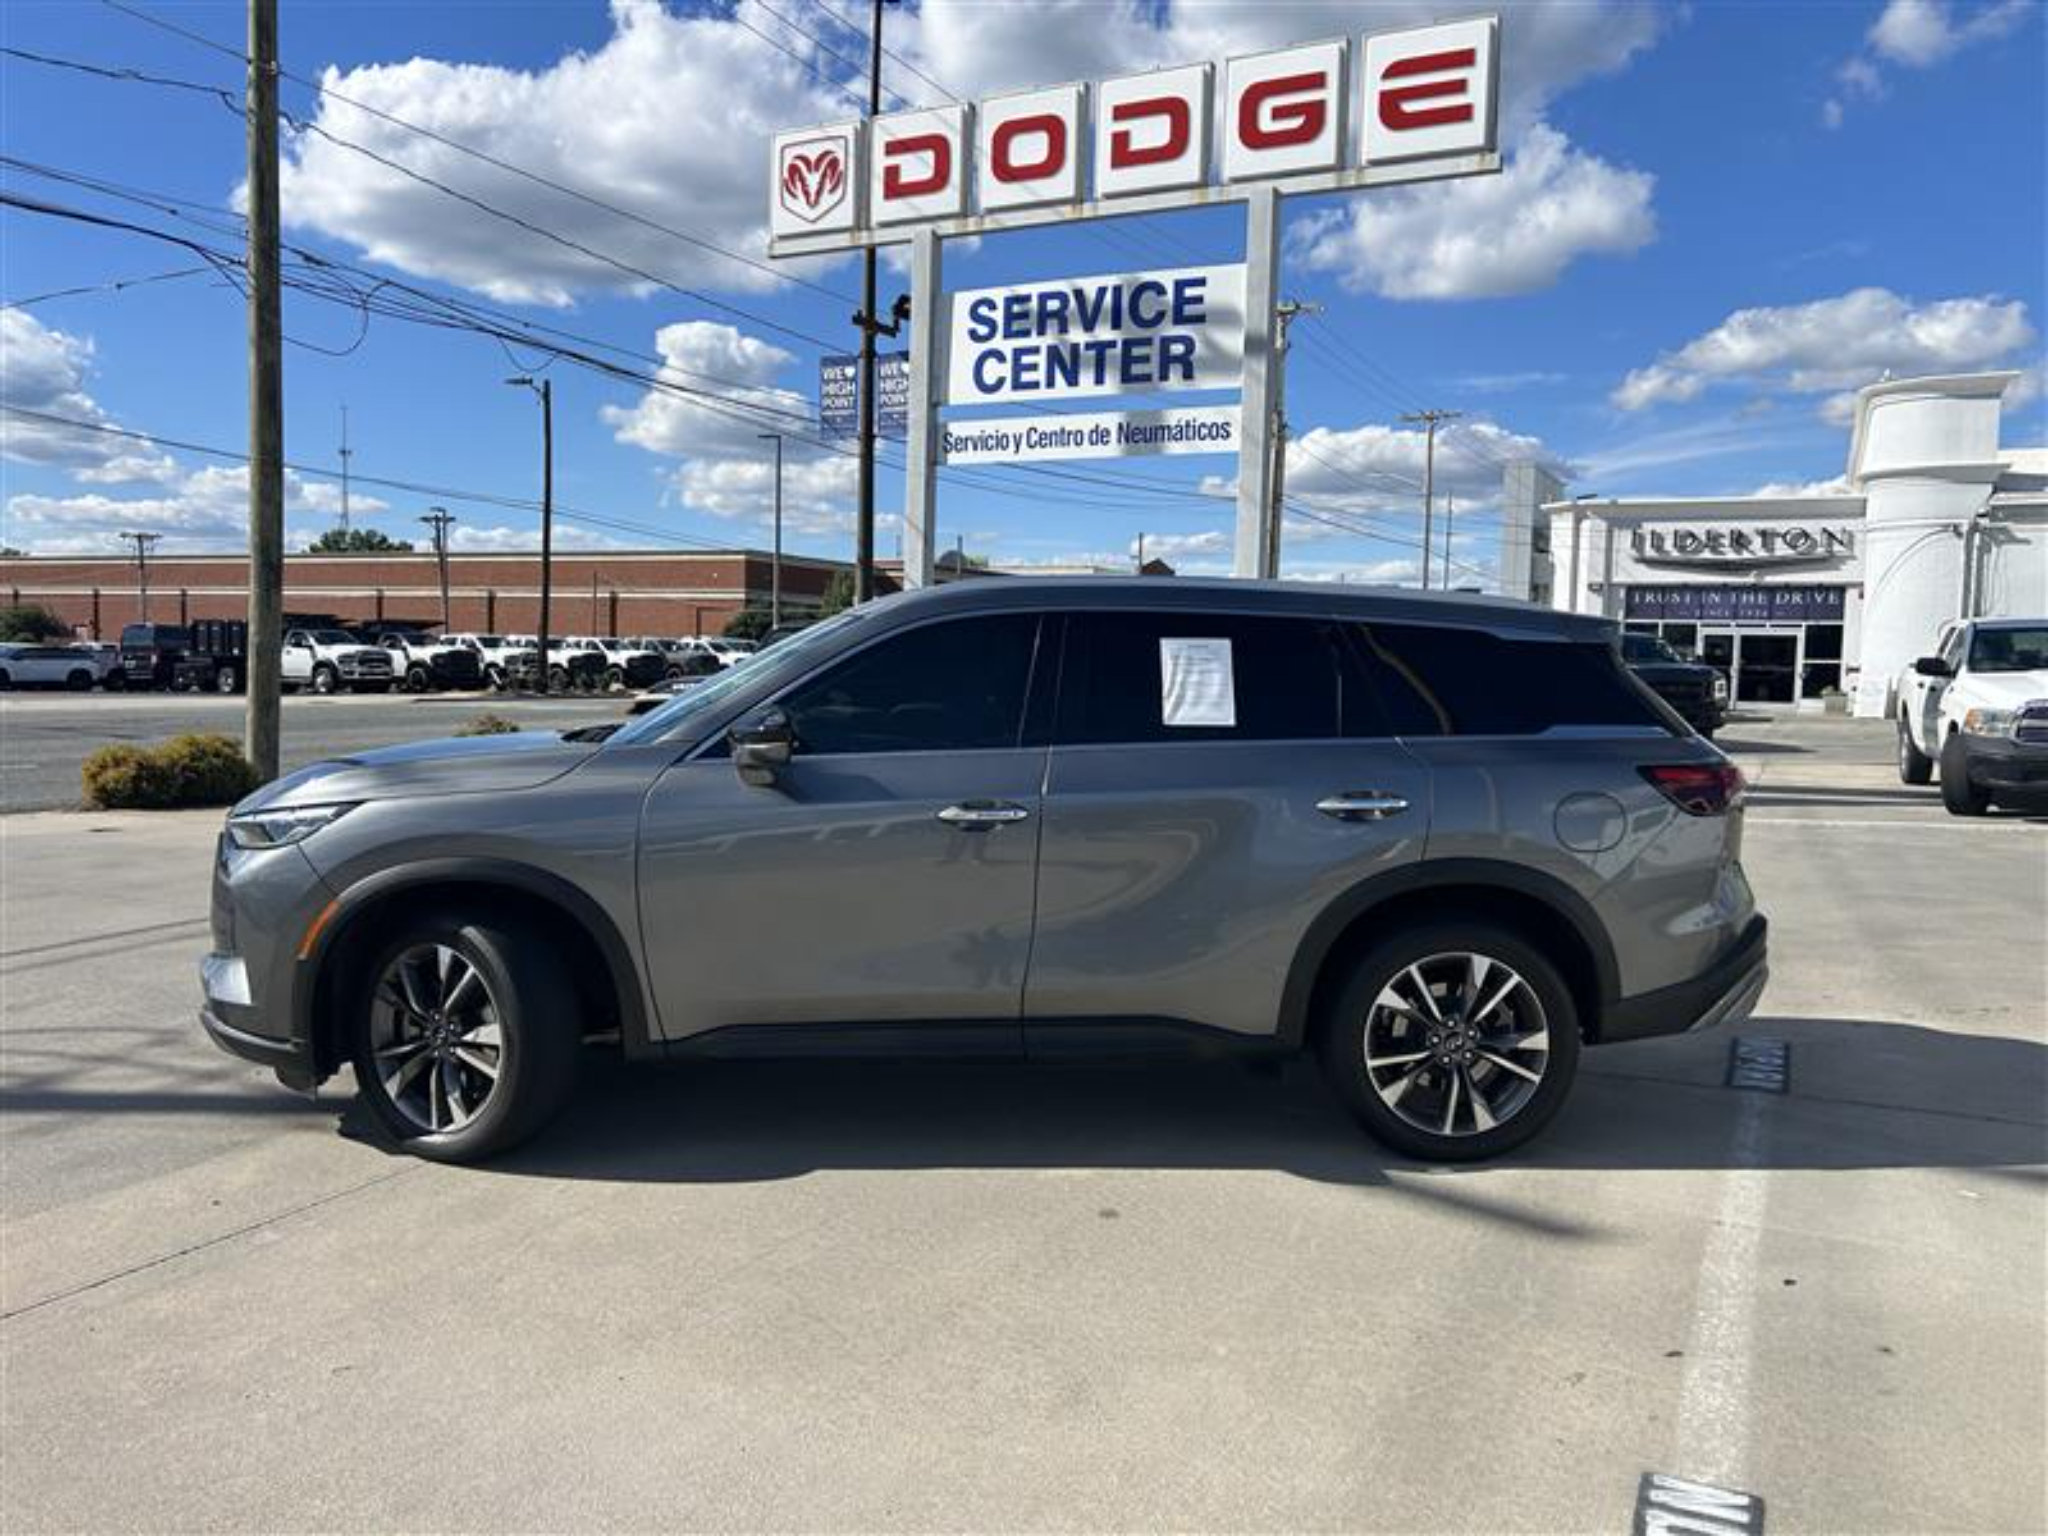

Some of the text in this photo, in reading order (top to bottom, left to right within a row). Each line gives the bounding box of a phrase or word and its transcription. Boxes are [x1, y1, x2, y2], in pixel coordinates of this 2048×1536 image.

[883, 48, 1476, 201] DODGE
[968, 277, 1207, 343] SERVICE
[822, 366, 844, 380] WE
[972, 335, 1197, 395] CENTER
[821, 381, 856, 395] HIGH
[821, 396, 855, 409] POINT
[942, 417, 1231, 455] Servicio y Centro de Neumáticos
[1631, 527, 1855, 556] ILDERTON
[1634, 592, 1840, 605] TRUST IN THE DRIVE
